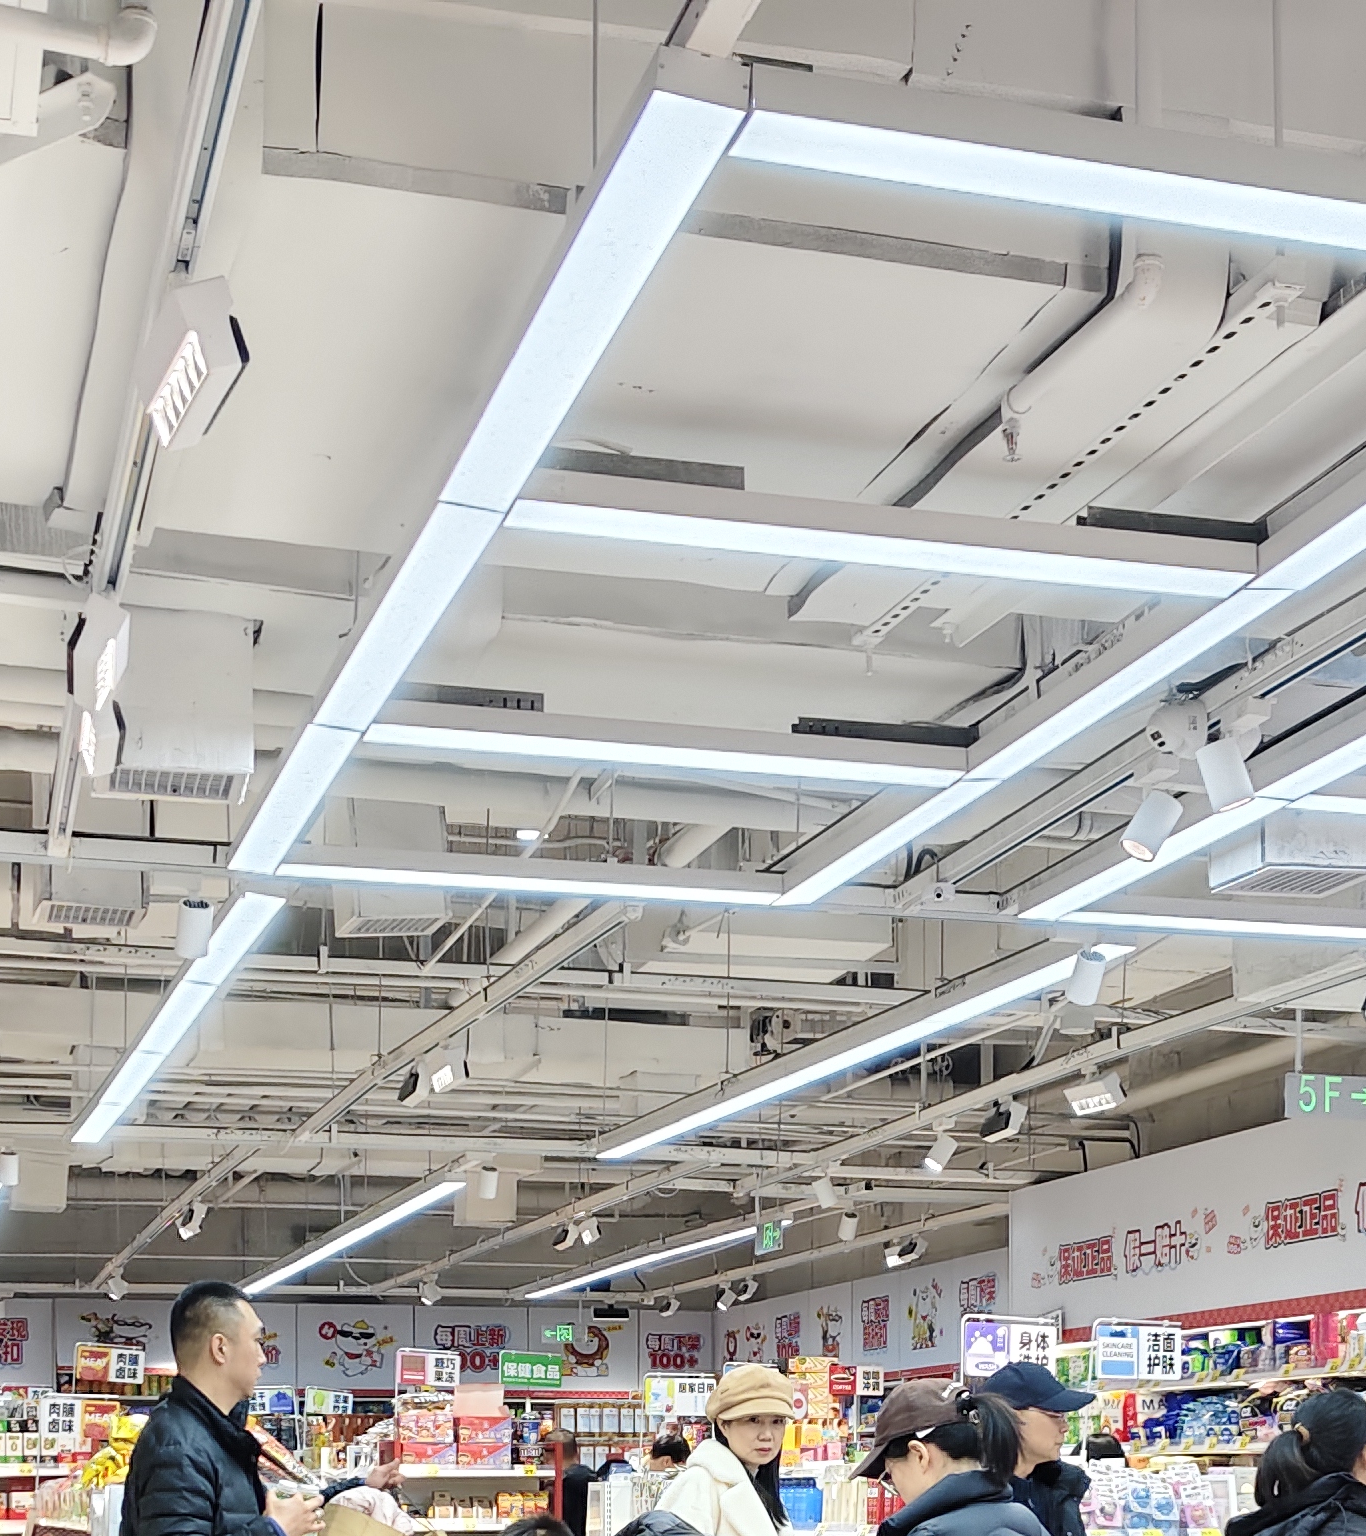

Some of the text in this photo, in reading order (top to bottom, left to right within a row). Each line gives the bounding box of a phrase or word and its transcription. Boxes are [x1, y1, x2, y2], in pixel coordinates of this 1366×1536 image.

[1264, 1189, 1339, 1249] 保证正品
[1124, 1221, 1187, 1274] 假一赔十
[1058, 1235, 1113, 1284] 保证正品
[434, 1324, 506, 1349] 每周上新
[646, 1333, 702, 1353] 每周下架
[1019, 1331, 1050, 1350] 身体
[1147, 1331, 1176, 1352] 洁面
[81, 1357, 109, 1368] MEAT
[459, 1350, 499, 1372] 00+
[503, 1362, 560, 1379] 保健食品
[648, 1352, 699, 1370] 100+
[1147, 1354, 1176, 1375] 护肤
